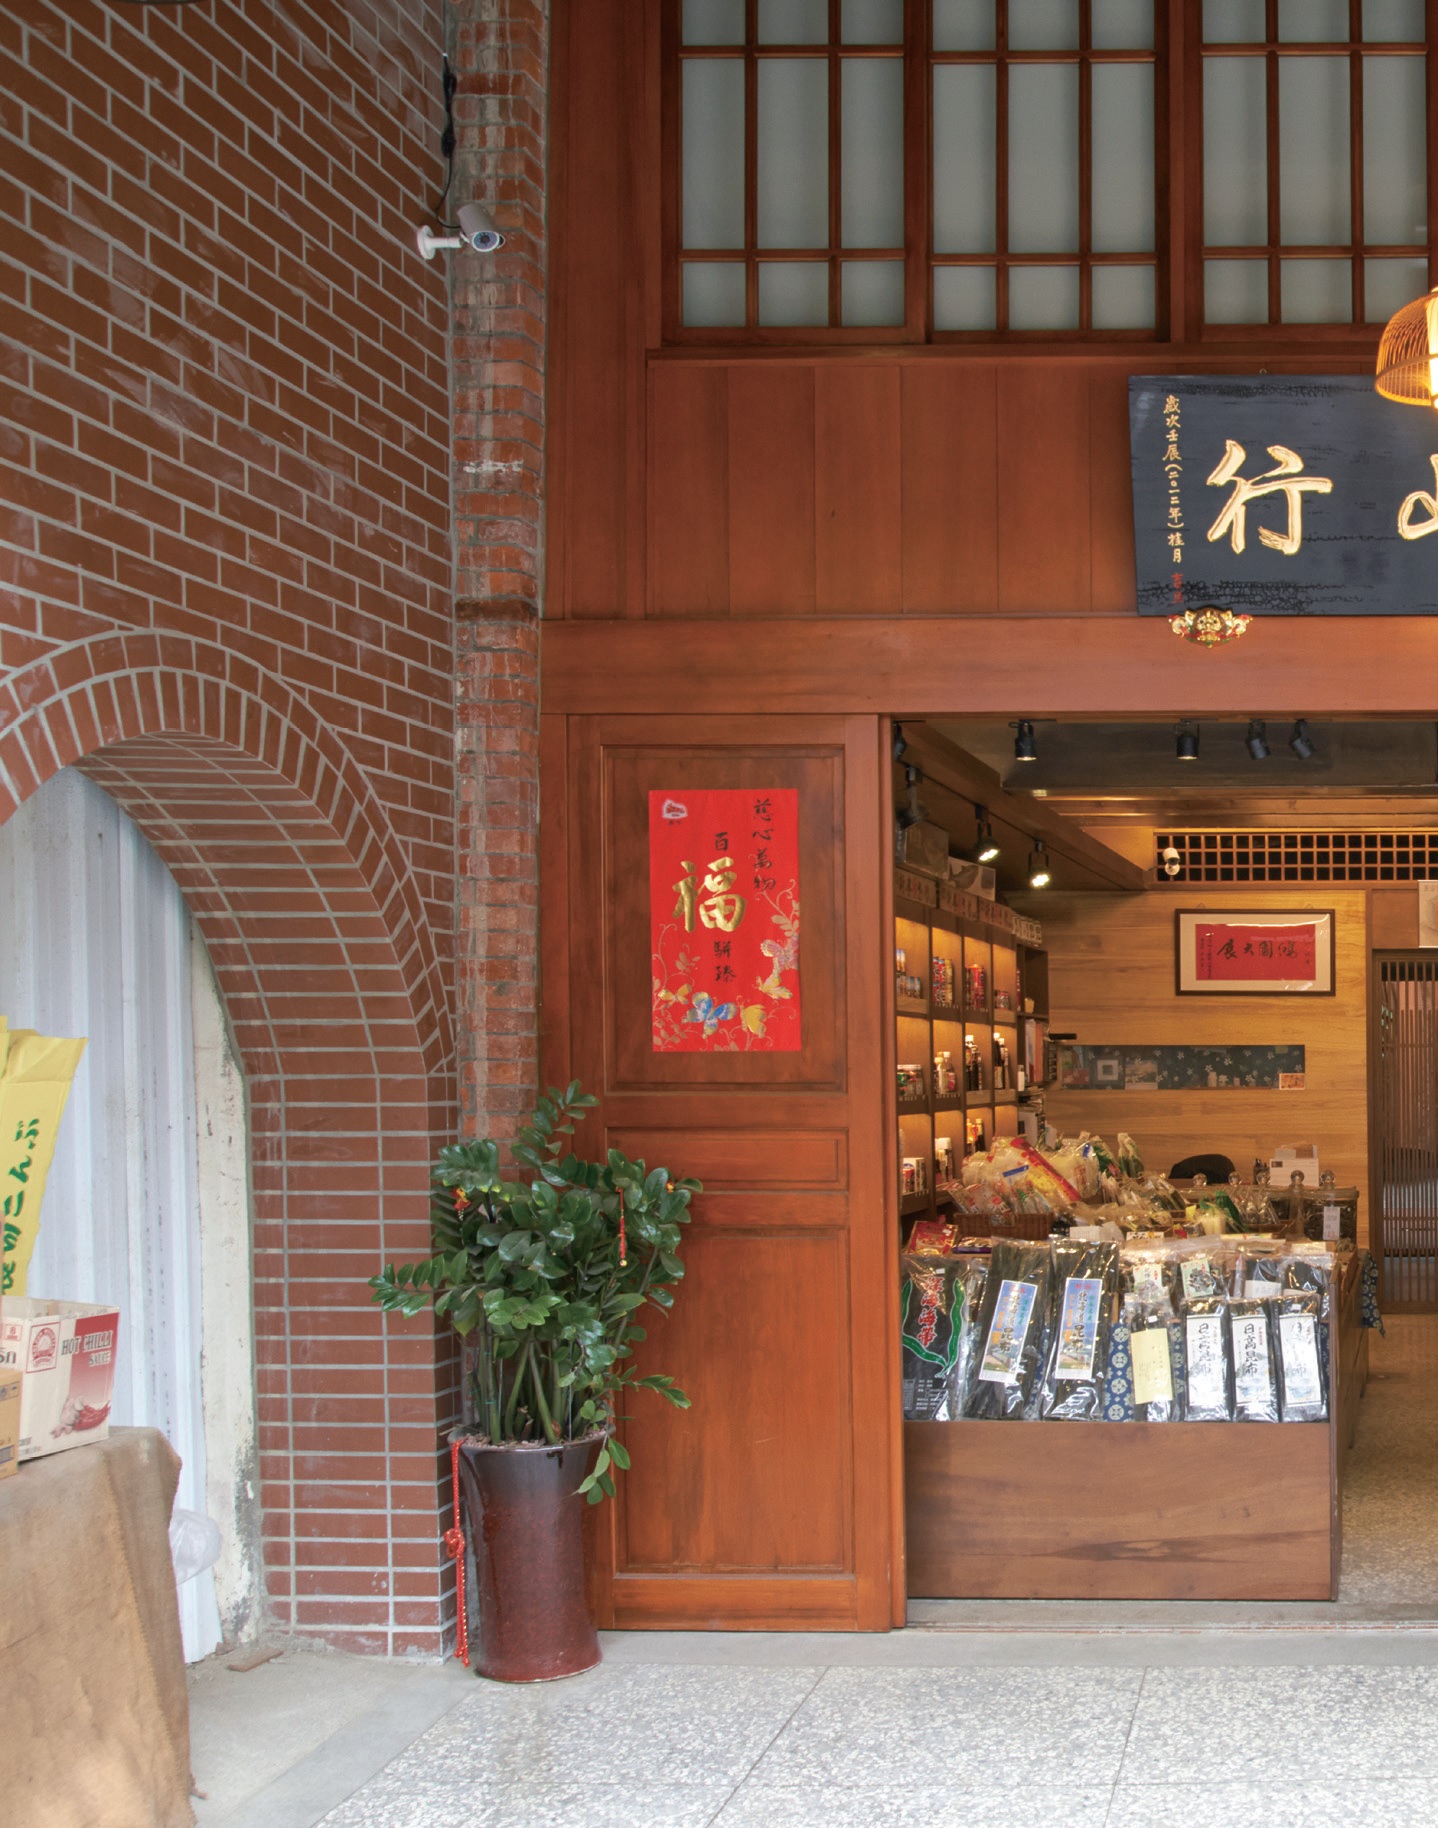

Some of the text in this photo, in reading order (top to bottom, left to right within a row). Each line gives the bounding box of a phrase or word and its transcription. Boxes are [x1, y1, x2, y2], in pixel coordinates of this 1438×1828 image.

[752, 798, 776, 891] 慈心萬物
[61, 1336, 81, 1356] HOT
[1244, 1323, 1258, 1377] 日高昆布
